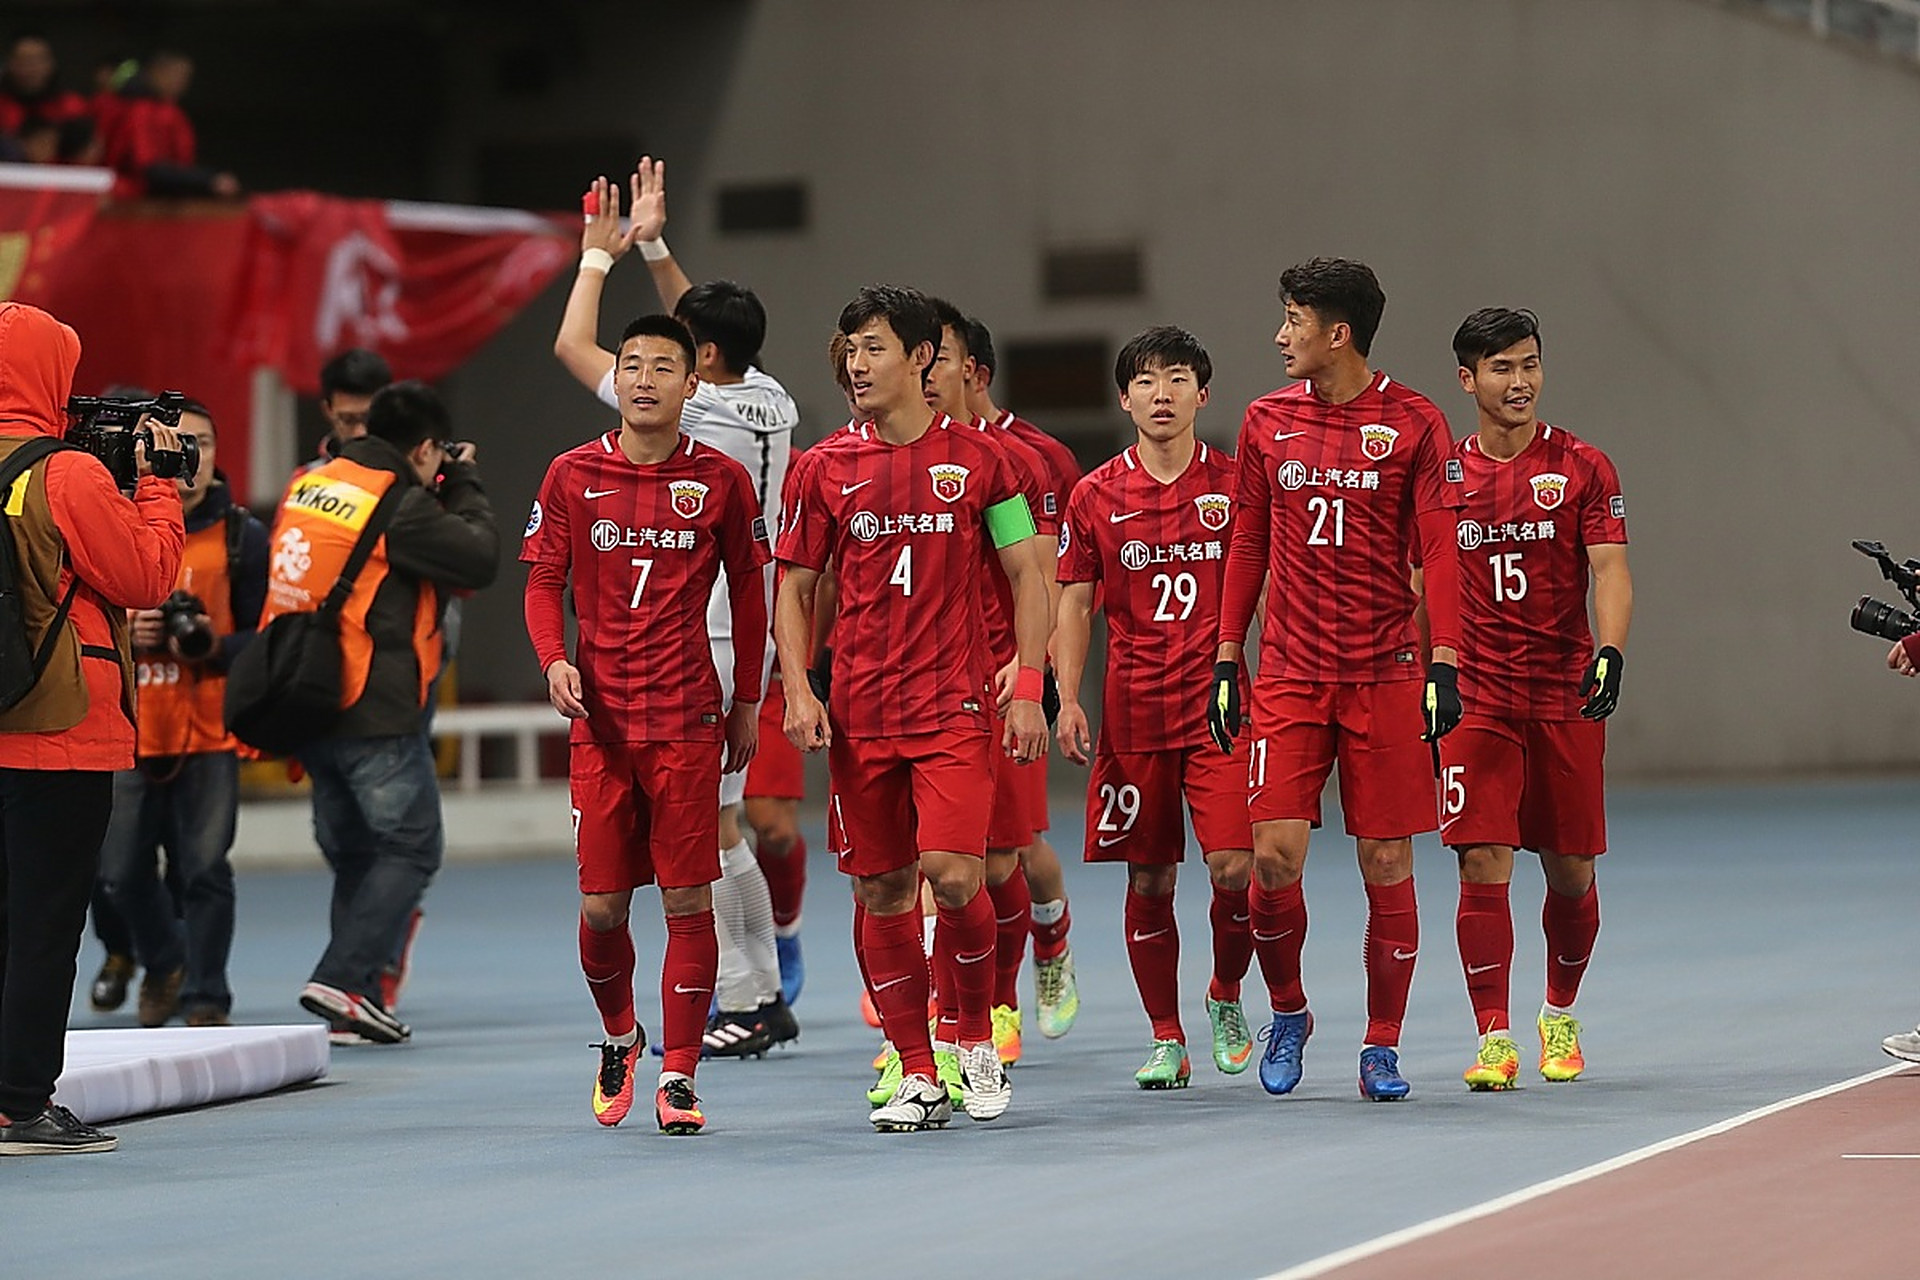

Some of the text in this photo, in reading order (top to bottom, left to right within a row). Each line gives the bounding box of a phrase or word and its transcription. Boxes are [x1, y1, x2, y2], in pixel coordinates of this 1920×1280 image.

[1280, 461, 1380, 490] MG 上汽名爵
[297, 482, 357, 520] Nikon
[1307, 496, 1344, 546] 21
[593, 521, 695, 549] MG 上汽名爵
[852, 513, 954, 540] MG 上汽名爵
[1458, 520, 1555, 548] MG 上汽名爵
[889, 545, 911, 596] 4
[1123, 541, 1222, 568] MG 上汽名爵
[630, 558, 654, 609] 7
[1151, 572, 1197, 621] 29
[1488, 552, 1528, 602] 15
[137, 662, 180, 686] 039
[1097, 783, 1140, 831] 29
[1442, 765, 1465, 815] 15
